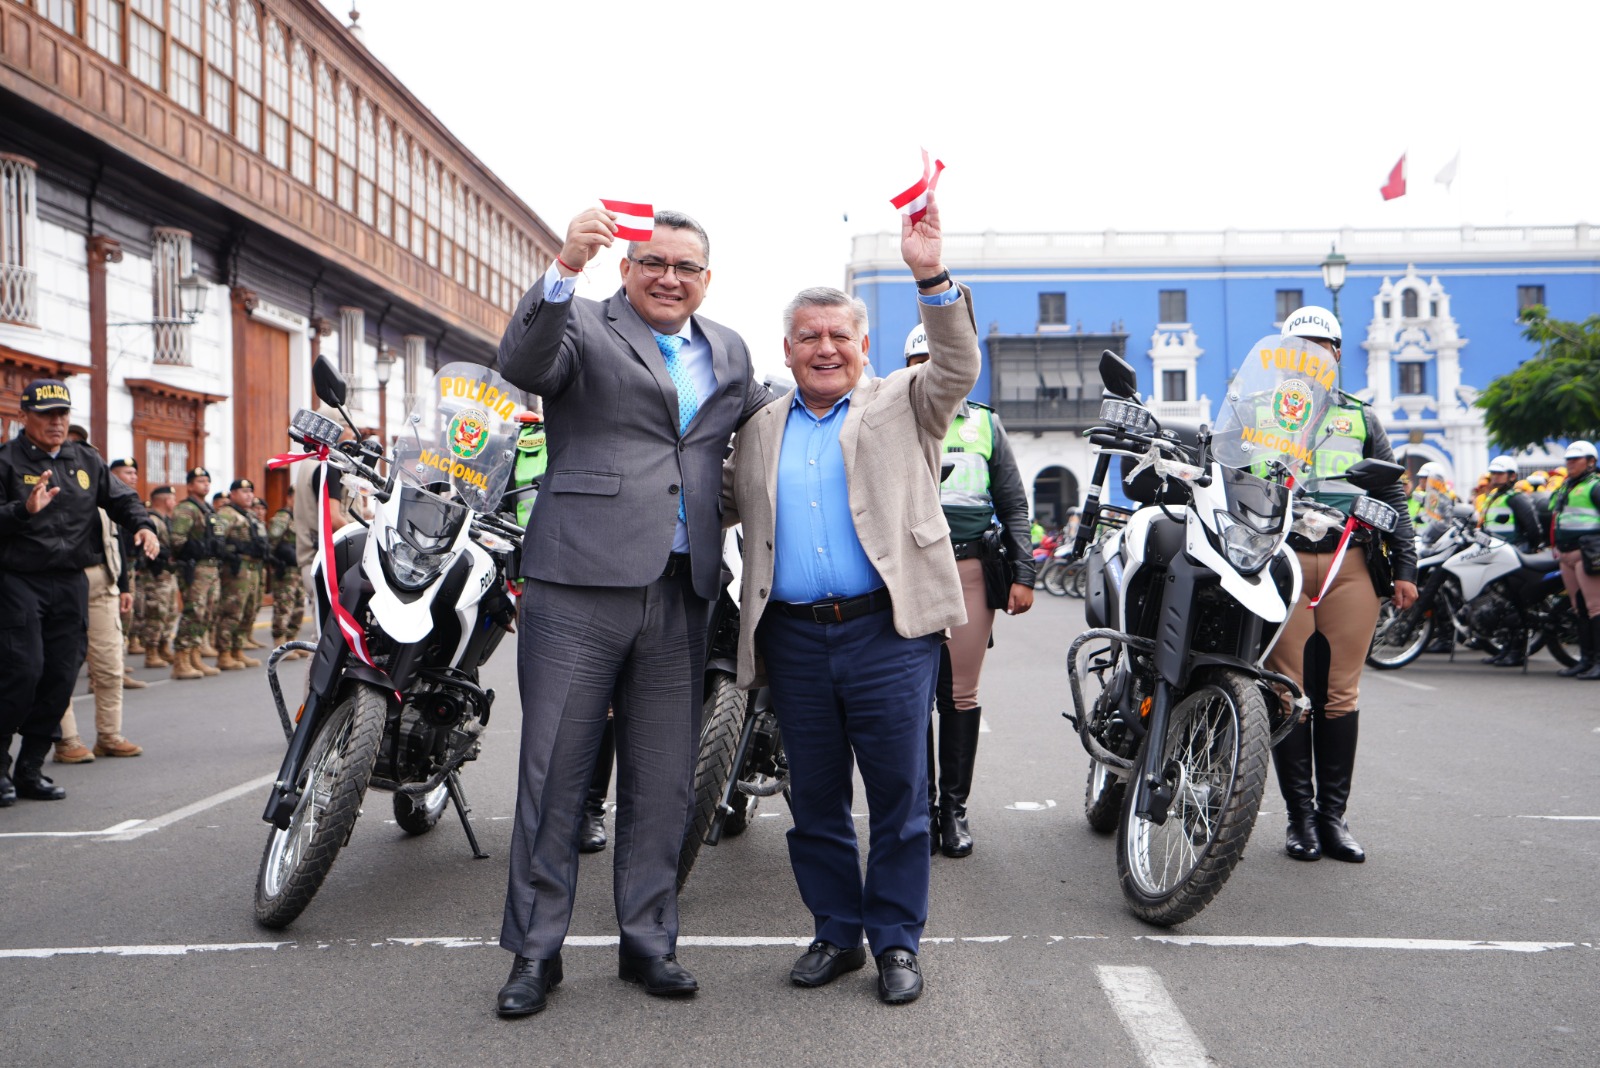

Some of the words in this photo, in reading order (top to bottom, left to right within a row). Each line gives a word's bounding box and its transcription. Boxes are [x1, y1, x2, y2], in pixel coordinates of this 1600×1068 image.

[1289, 316, 1330, 333] POLICIA
[1260, 347, 1336, 392] POLICÍA
[35, 384, 70, 402] POLICIA
[440, 376, 516, 422] POLICÍA
[1241, 425, 1313, 466] NACIONAL
[419, 449, 489, 490] NACIONAL
